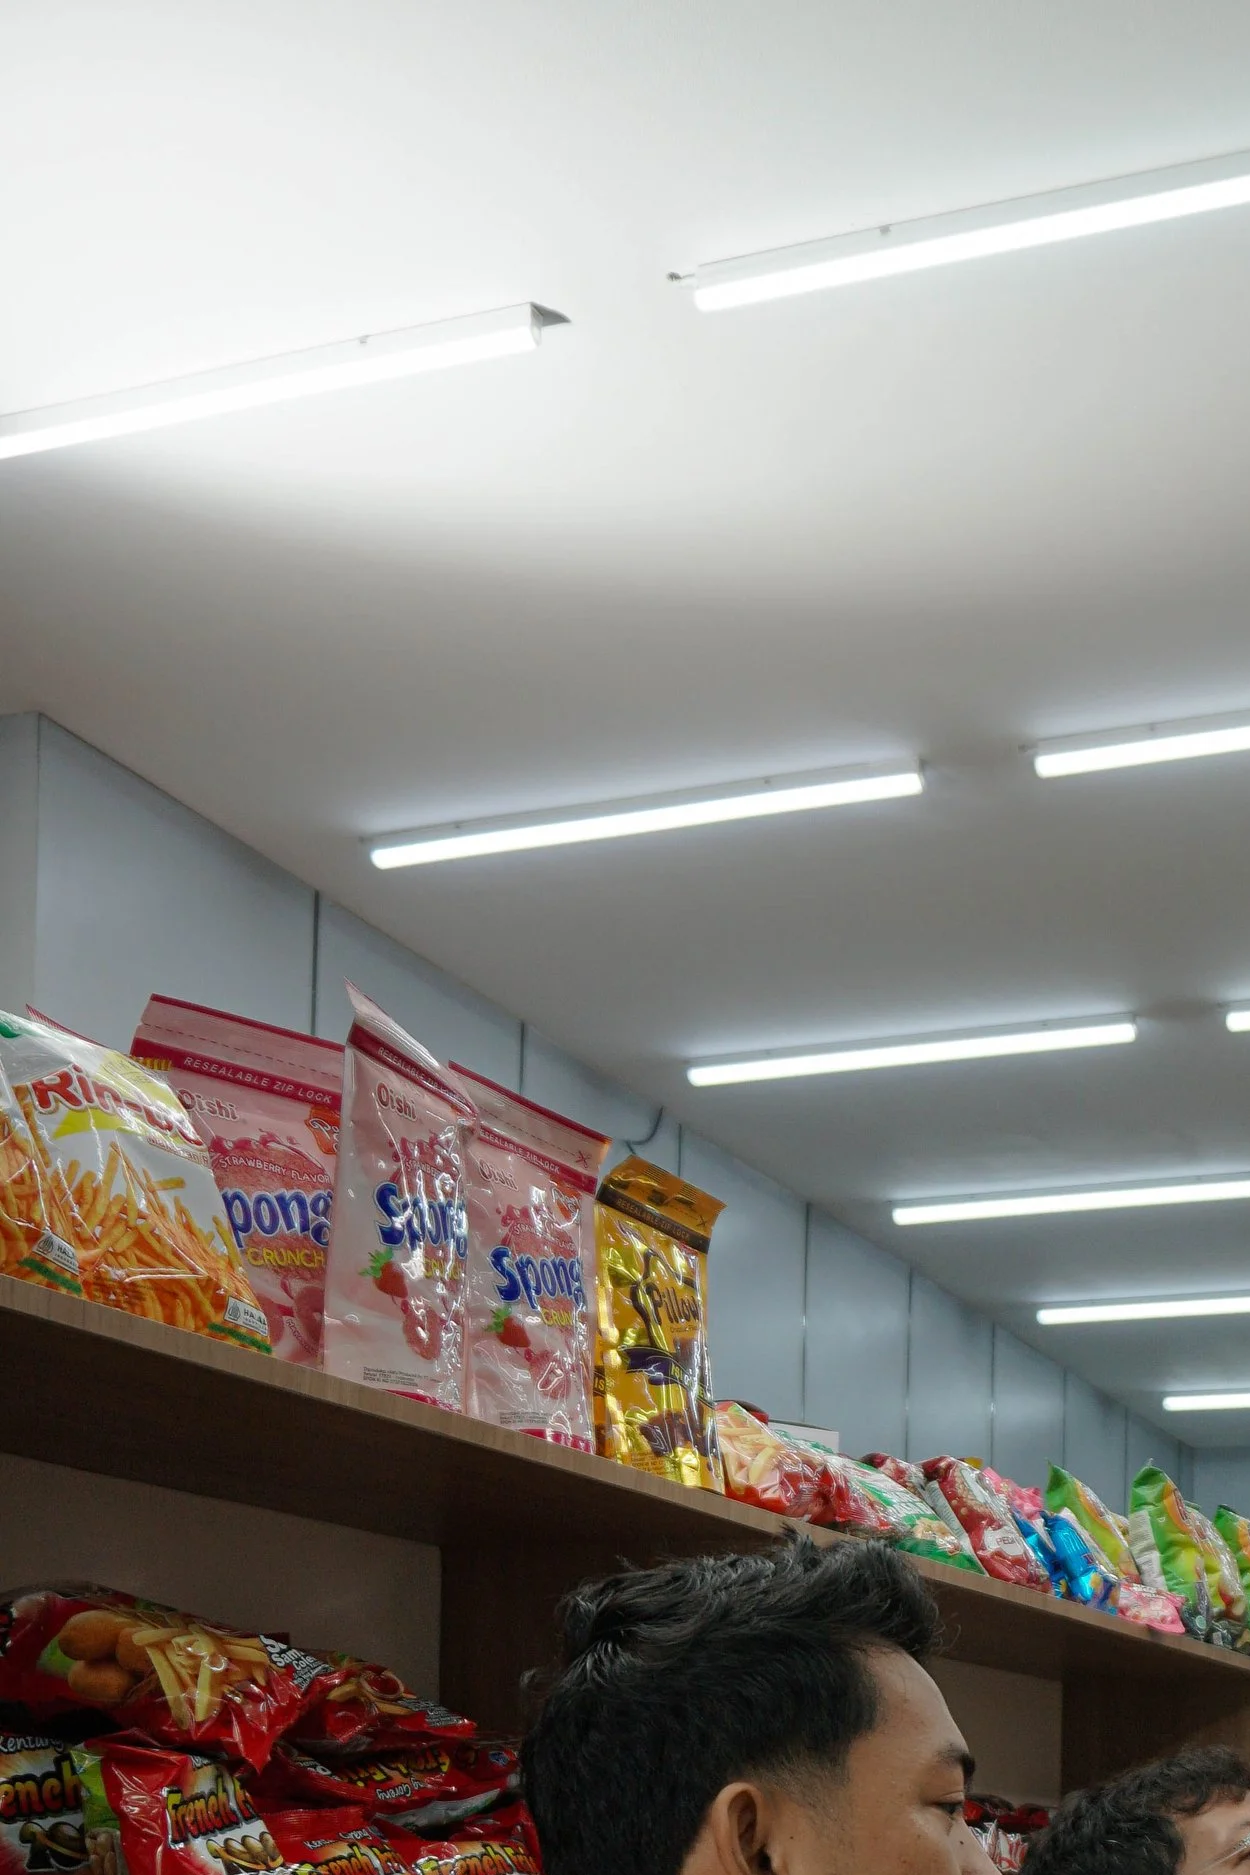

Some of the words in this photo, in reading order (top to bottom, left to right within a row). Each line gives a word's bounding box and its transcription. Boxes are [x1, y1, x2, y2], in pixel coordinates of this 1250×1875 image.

[184, 1056, 268, 1088] RESEALABLE
[273, 1080, 294, 1093] ZIP
[298, 1087, 332, 1105] LOCK
[177, 1087, 241, 1123] Oishi
[375, 1082, 417, 1122] Oishi
[218, 1155, 288, 1176] STRAWBERRY
[290, 1168, 333, 1186] FLAVOR
[479, 1160, 518, 1192] Oishi
[540, 1159, 561, 1174] LOCK
[617, 1197, 659, 1225] RESEALABLE
[247, 1248, 324, 1269] CRUNCH
